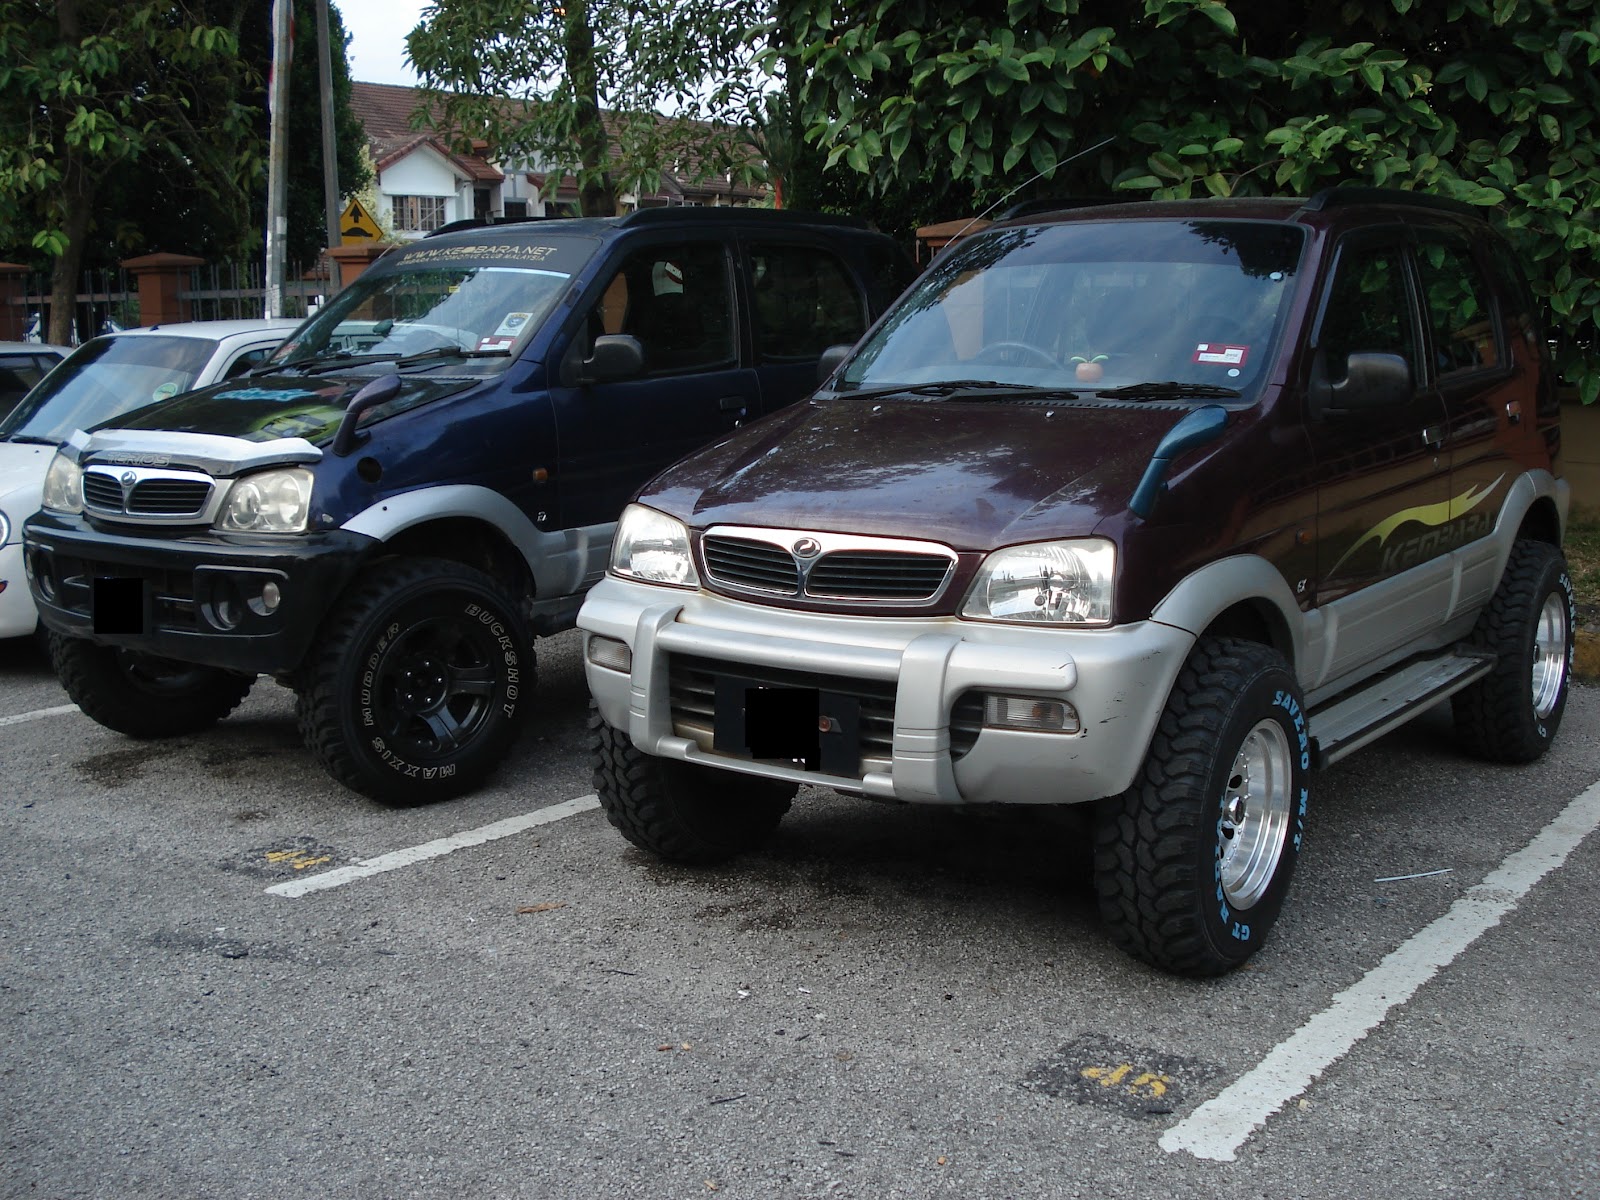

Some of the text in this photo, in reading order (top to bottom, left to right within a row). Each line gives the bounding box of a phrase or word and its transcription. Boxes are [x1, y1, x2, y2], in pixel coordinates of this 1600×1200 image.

[403, 245, 557, 260] WWW.KEBARA.NET
[432, 253, 479, 262] AUTOMOTIVE
[503, 253, 545, 262] MALAYSIA
[107, 451, 172, 467] TERIOS
[361, 622, 399, 727] MUDDER
[464, 603, 519, 718] BUCKSHOT
[372, 736, 456, 779] MAXXIS
[1271, 690, 1309, 852] SAVERO M/T
[1232, 921, 1250, 941] GT
